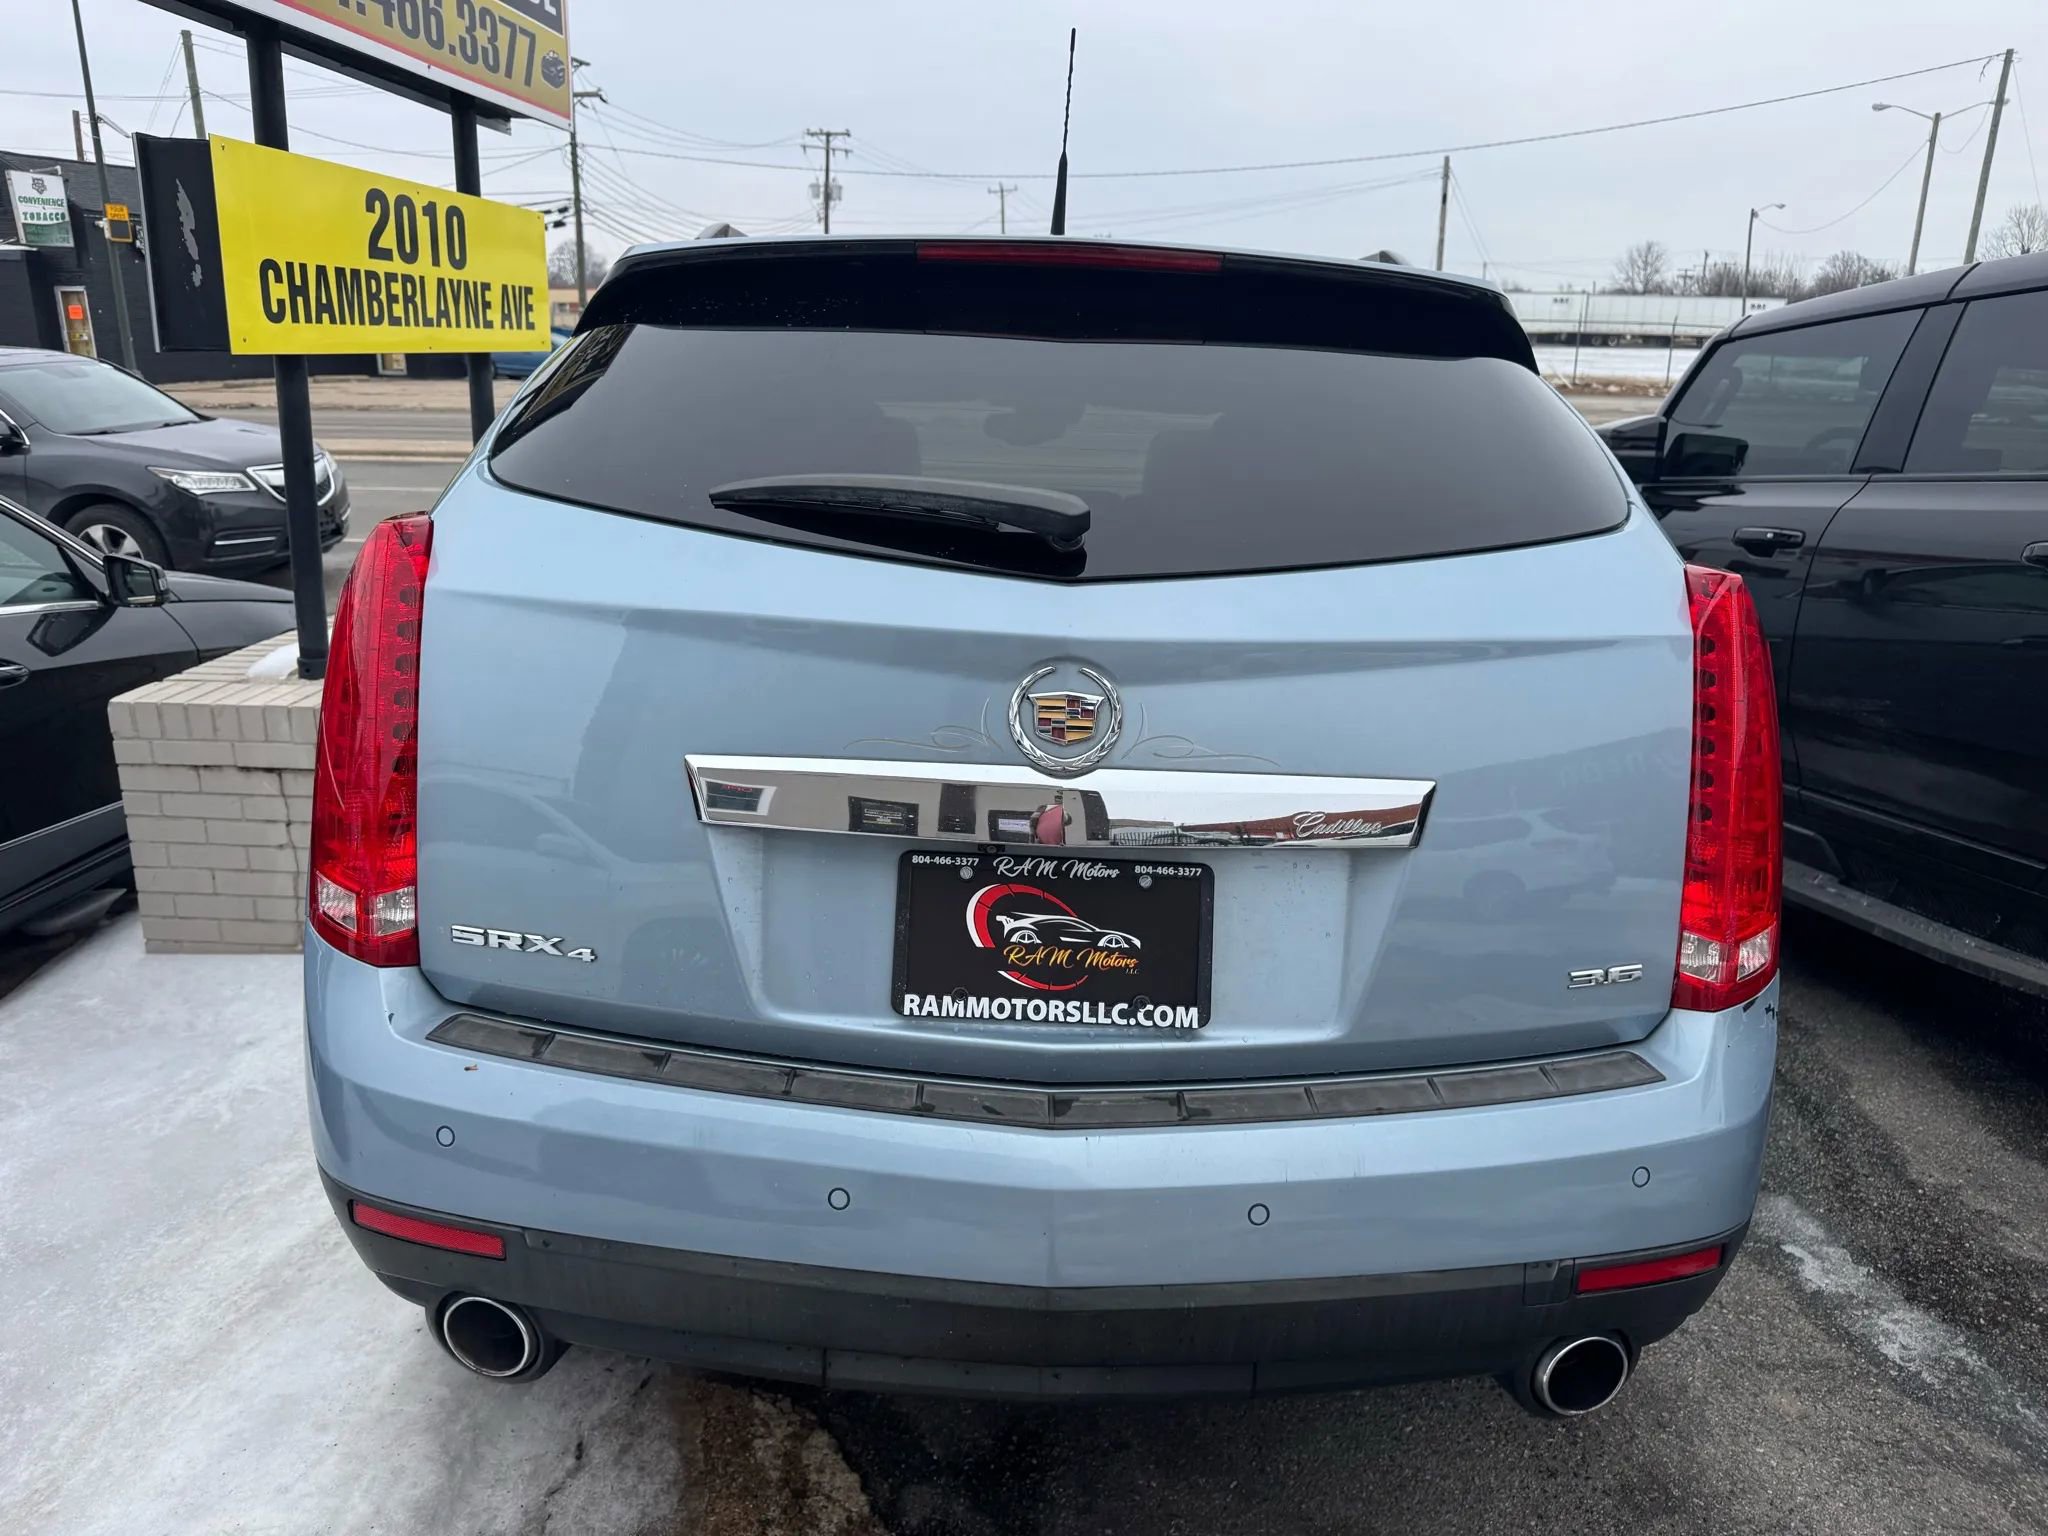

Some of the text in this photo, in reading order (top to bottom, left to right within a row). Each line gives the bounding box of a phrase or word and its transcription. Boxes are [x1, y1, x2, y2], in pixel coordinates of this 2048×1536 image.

[18, 196, 65, 208] CONVENIENCE
[22, 211, 67, 221] TOBACCO
[364, 187, 468, 271] 2010
[259, 258, 536, 331] CHAMBERLAYNE AVE
[1293, 811, 1382, 838] Cadillac
[912, 854, 979, 867] 804-466-3377
[993, 855, 1121, 880] RAM Motors
[1134, 865, 1202, 877] 804-466-3377
[1003, 945, 1139, 969] RAM Motors
[903, 993, 1200, 1029] RAMMOTORSLLC.COM
